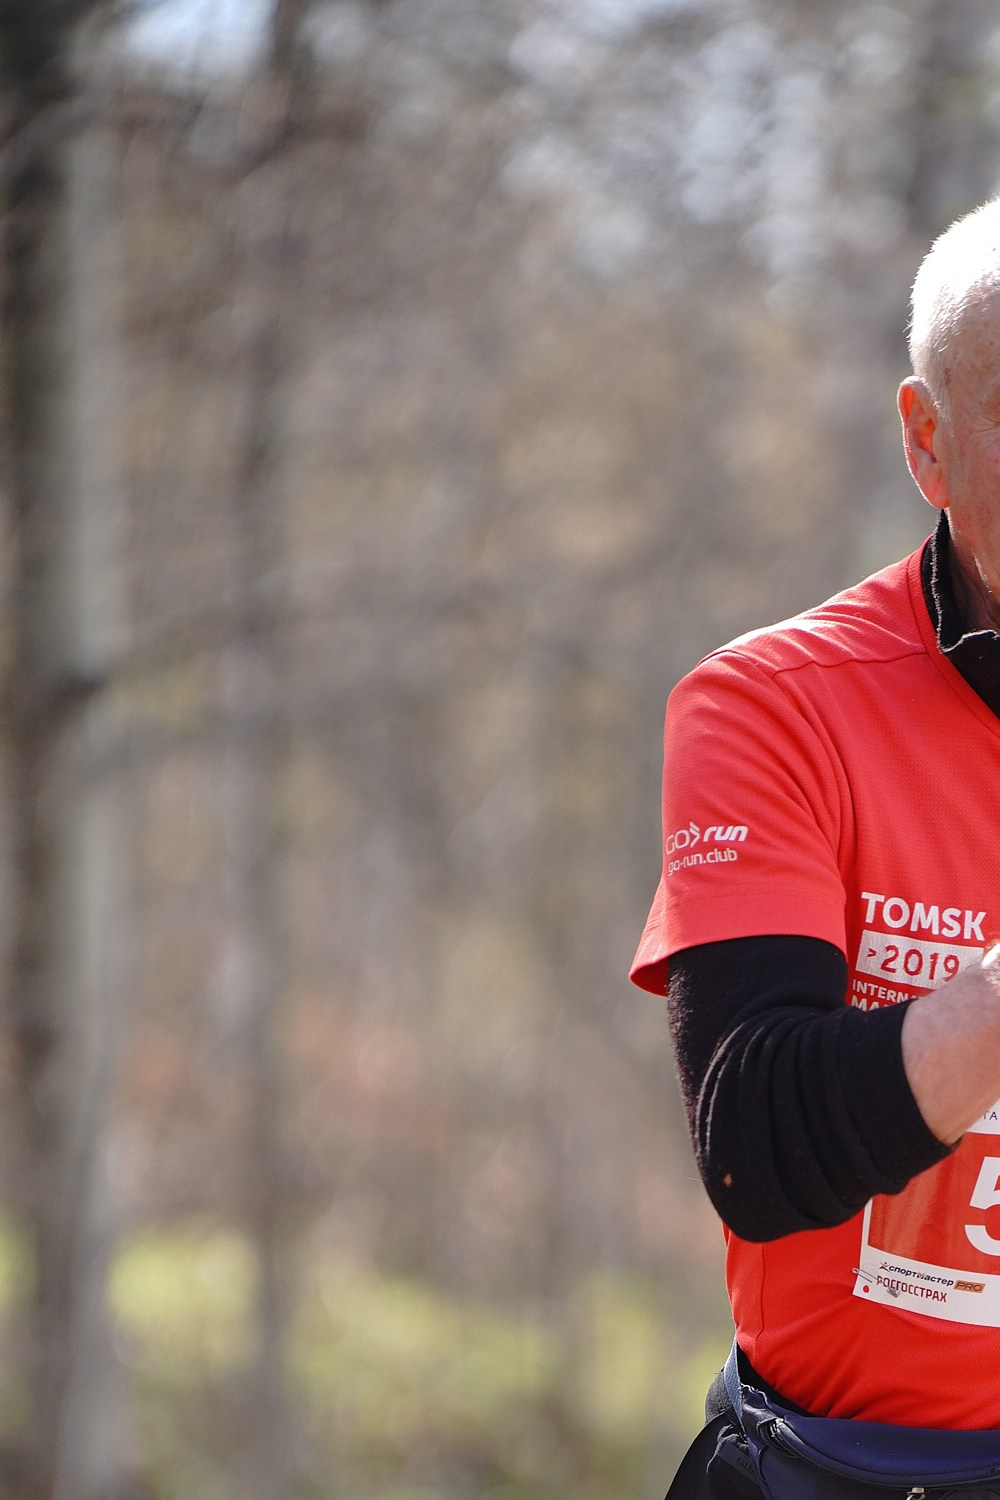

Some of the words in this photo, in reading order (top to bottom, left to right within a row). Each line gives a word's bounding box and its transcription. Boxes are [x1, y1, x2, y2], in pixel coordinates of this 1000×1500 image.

[667, 847, 738, 877] go-run.club
[860, 891, 986, 942] TOMSK
[852, 978, 920, 1004] INTERN
[876, 1274, 948, 1303] РОСГОССТРАХ
[955, 1281, 984, 1293] PRO
